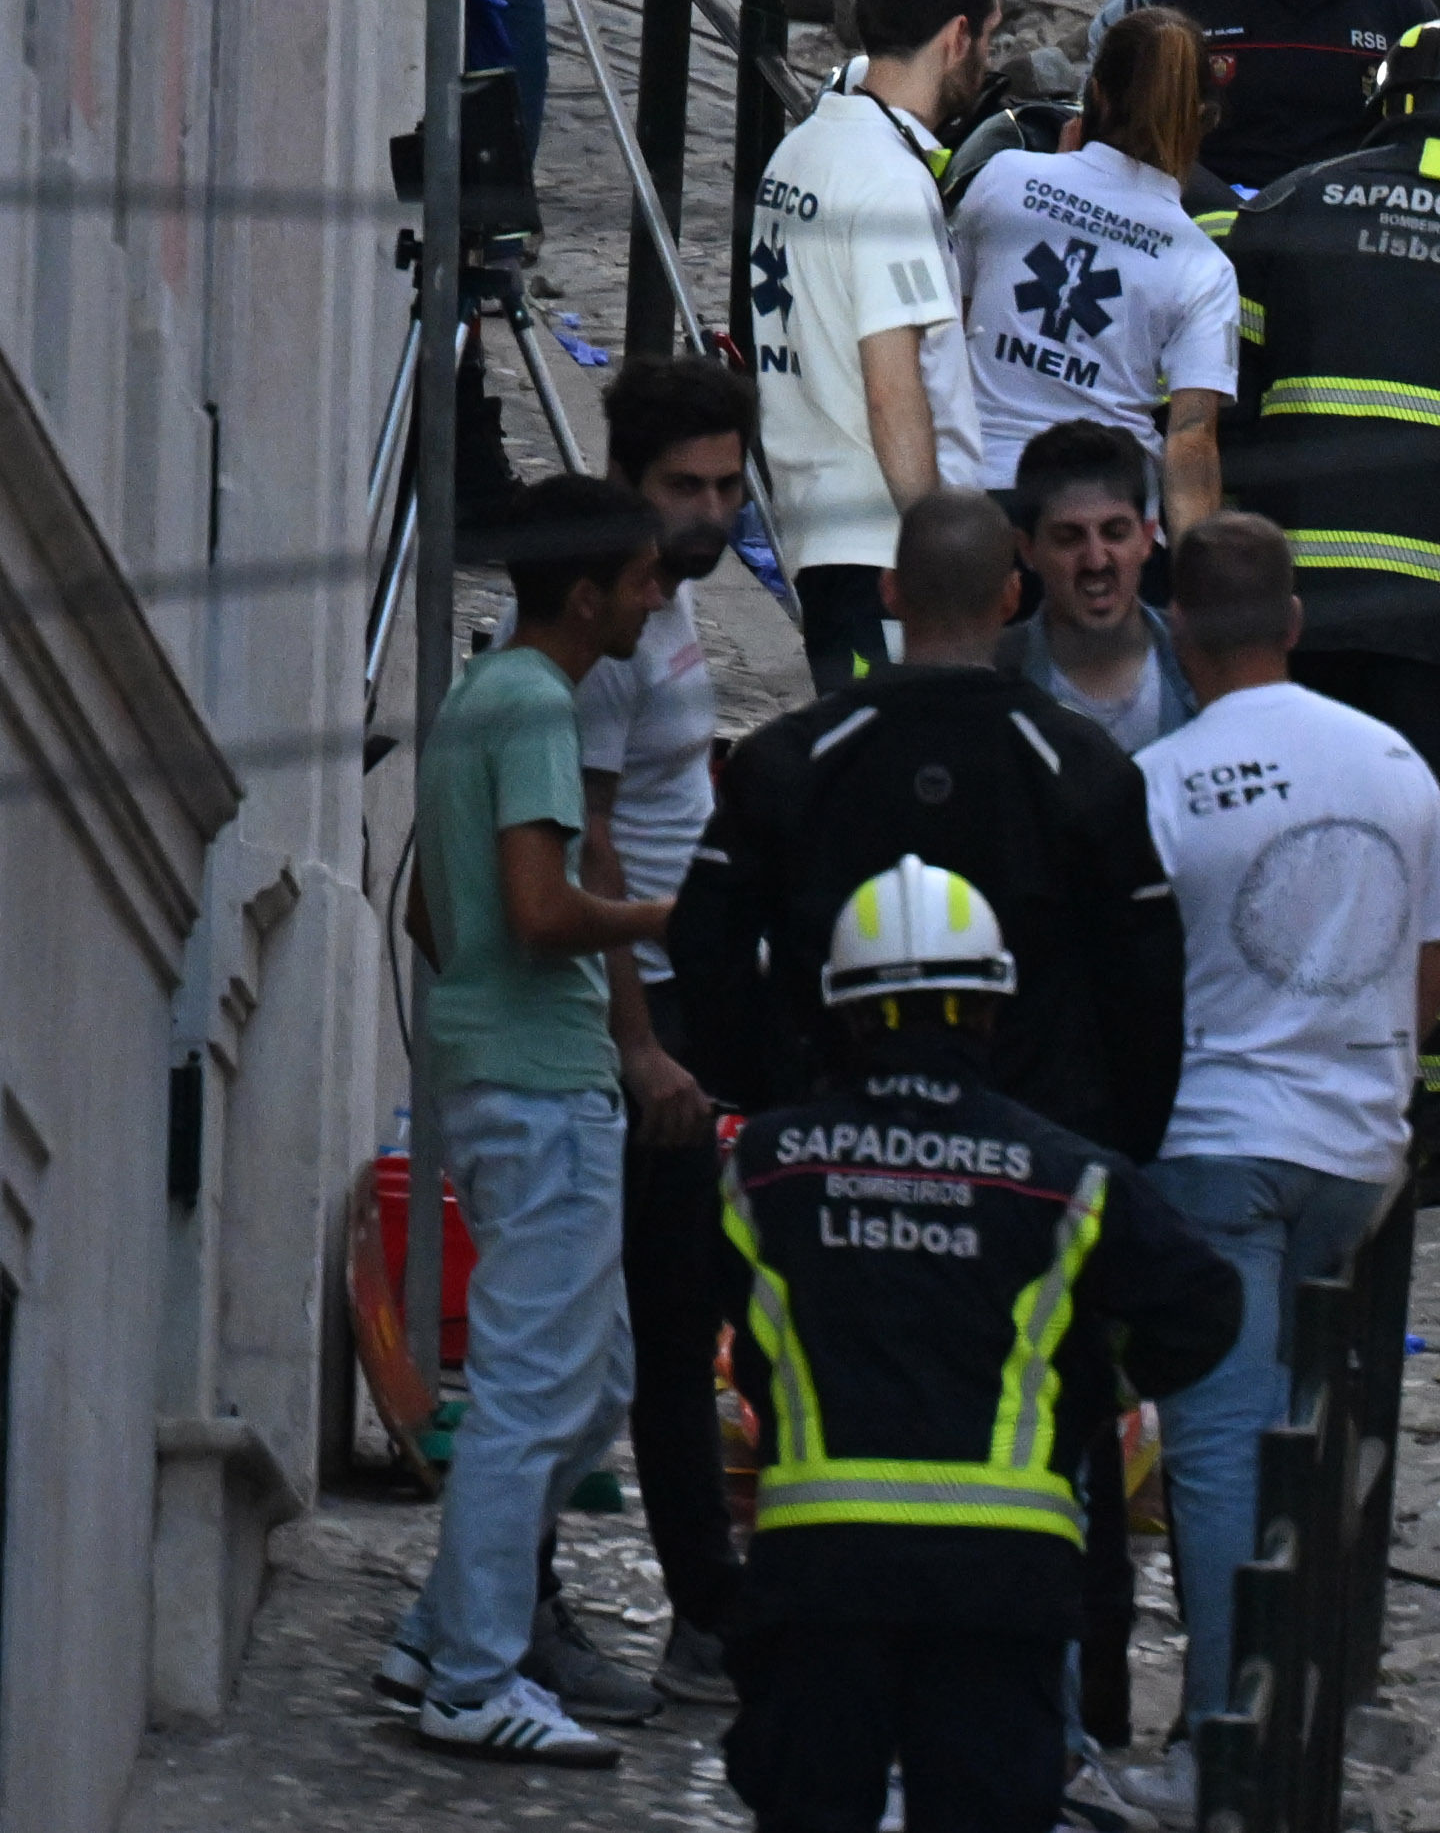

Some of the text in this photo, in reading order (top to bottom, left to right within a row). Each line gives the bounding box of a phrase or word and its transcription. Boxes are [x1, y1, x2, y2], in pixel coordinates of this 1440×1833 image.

[1350, 29, 1388, 51] RSB
[1022, 195, 1161, 260] OPERACIONAL
[1025, 178, 1174, 248] COORDENADOR
[994, 332, 1101, 389] INEM
[1183, 761, 1280, 793] CON-
[1188, 780, 1291, 816] CEPT
[775, 1123, 1033, 1182] SAPADORES
[818, 1204, 981, 1259] Lisboa
